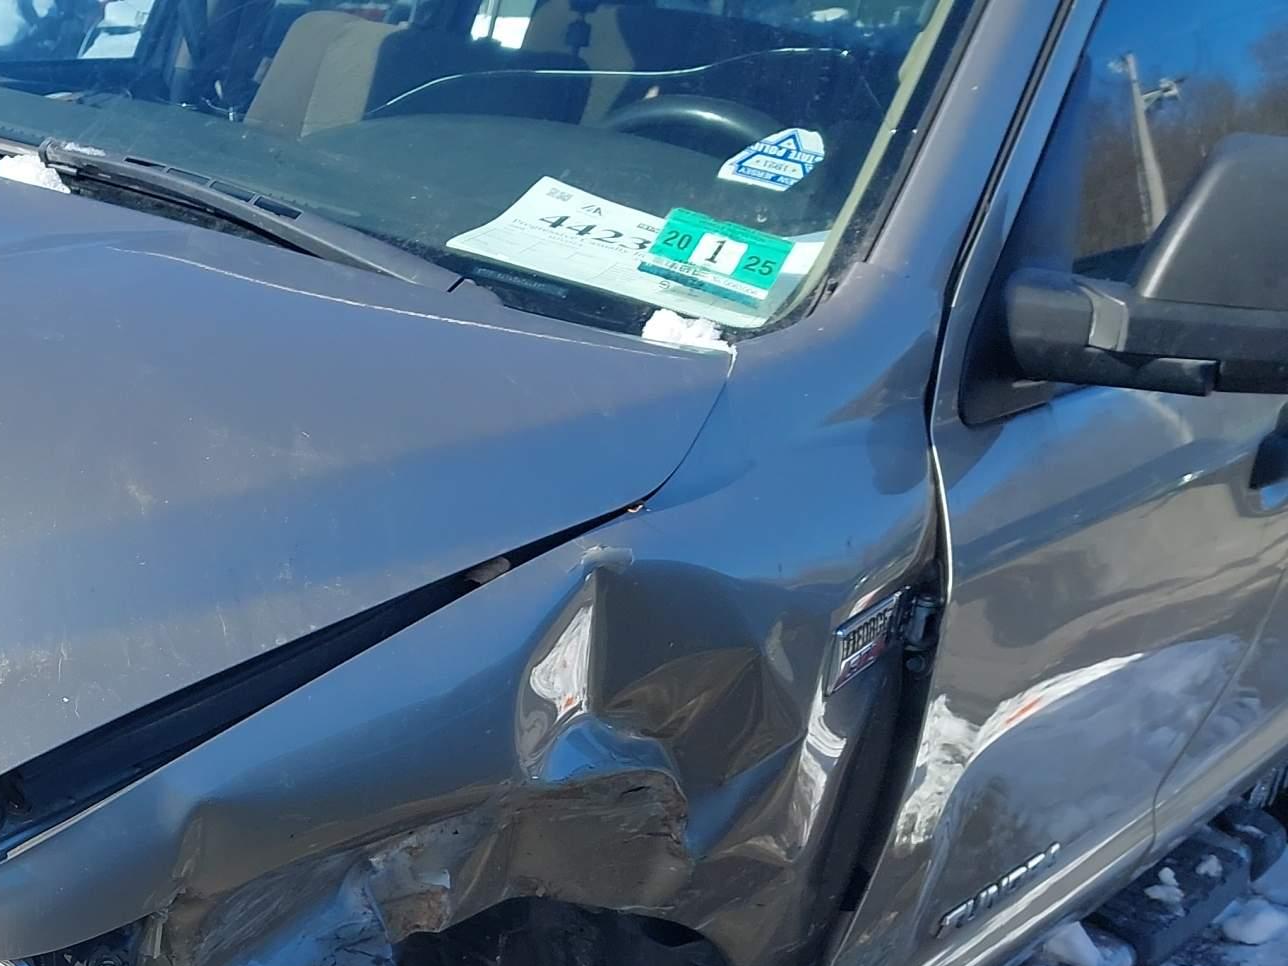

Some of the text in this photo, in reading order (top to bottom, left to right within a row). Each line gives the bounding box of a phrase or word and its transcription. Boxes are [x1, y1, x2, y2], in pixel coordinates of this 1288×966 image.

[663, 229, 692, 251] 20
[704, 239, 727, 264] 1
[742, 254, 777, 276] 25
